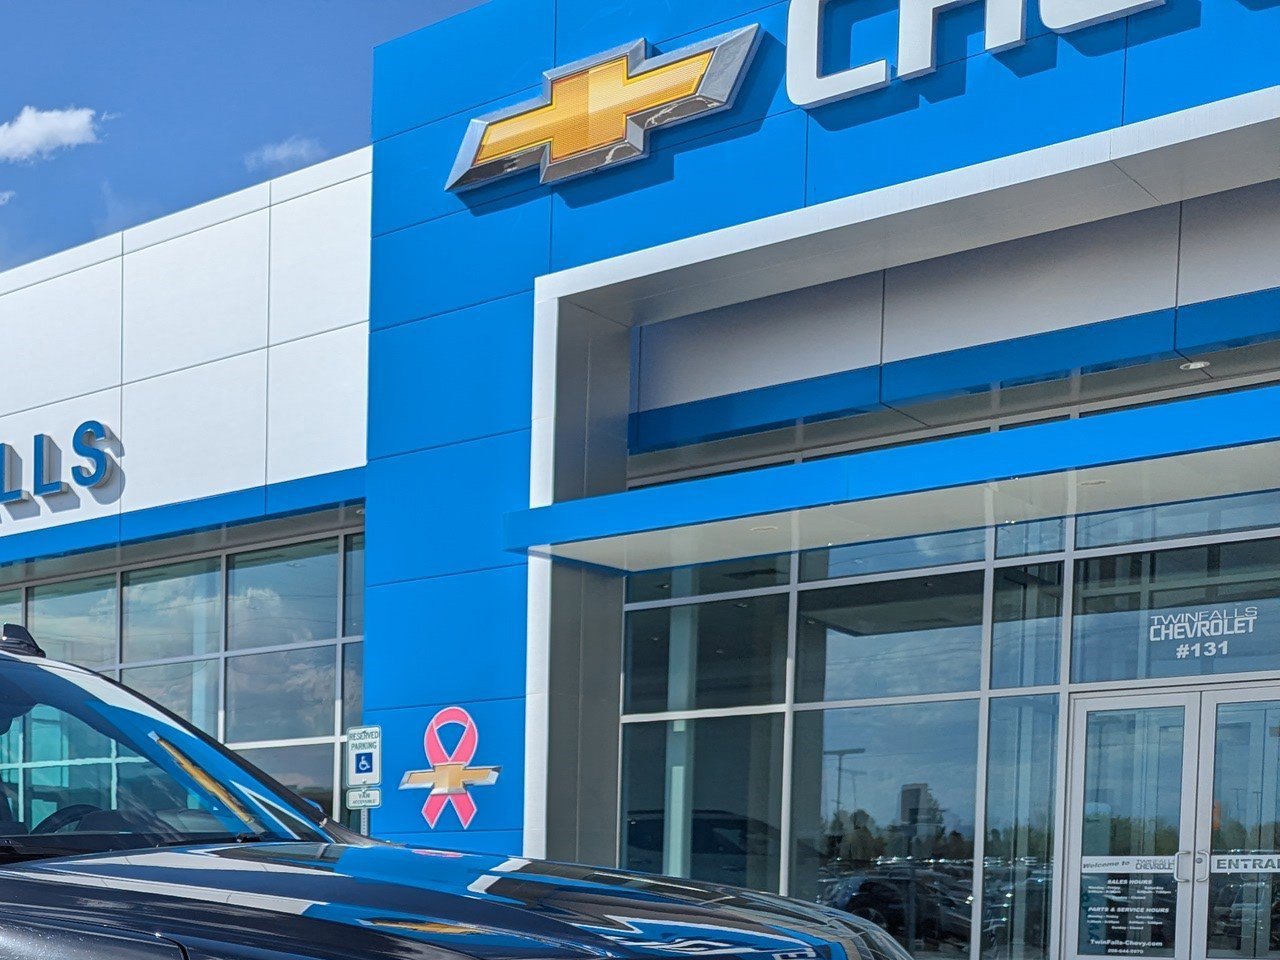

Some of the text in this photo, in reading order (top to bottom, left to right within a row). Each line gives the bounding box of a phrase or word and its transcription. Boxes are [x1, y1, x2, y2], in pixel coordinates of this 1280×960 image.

[1150, 607, 1258, 625] TWINFALLS
[1150, 616, 1258, 642] CHEVROLET
[1176, 641, 1228, 659] #131
[349, 731, 379, 741] RESERVED
[351, 742, 377, 751] PARKING
[1082, 861, 1120, 869] Welcome
[1216, 858, 1280, 870] ENTRA
